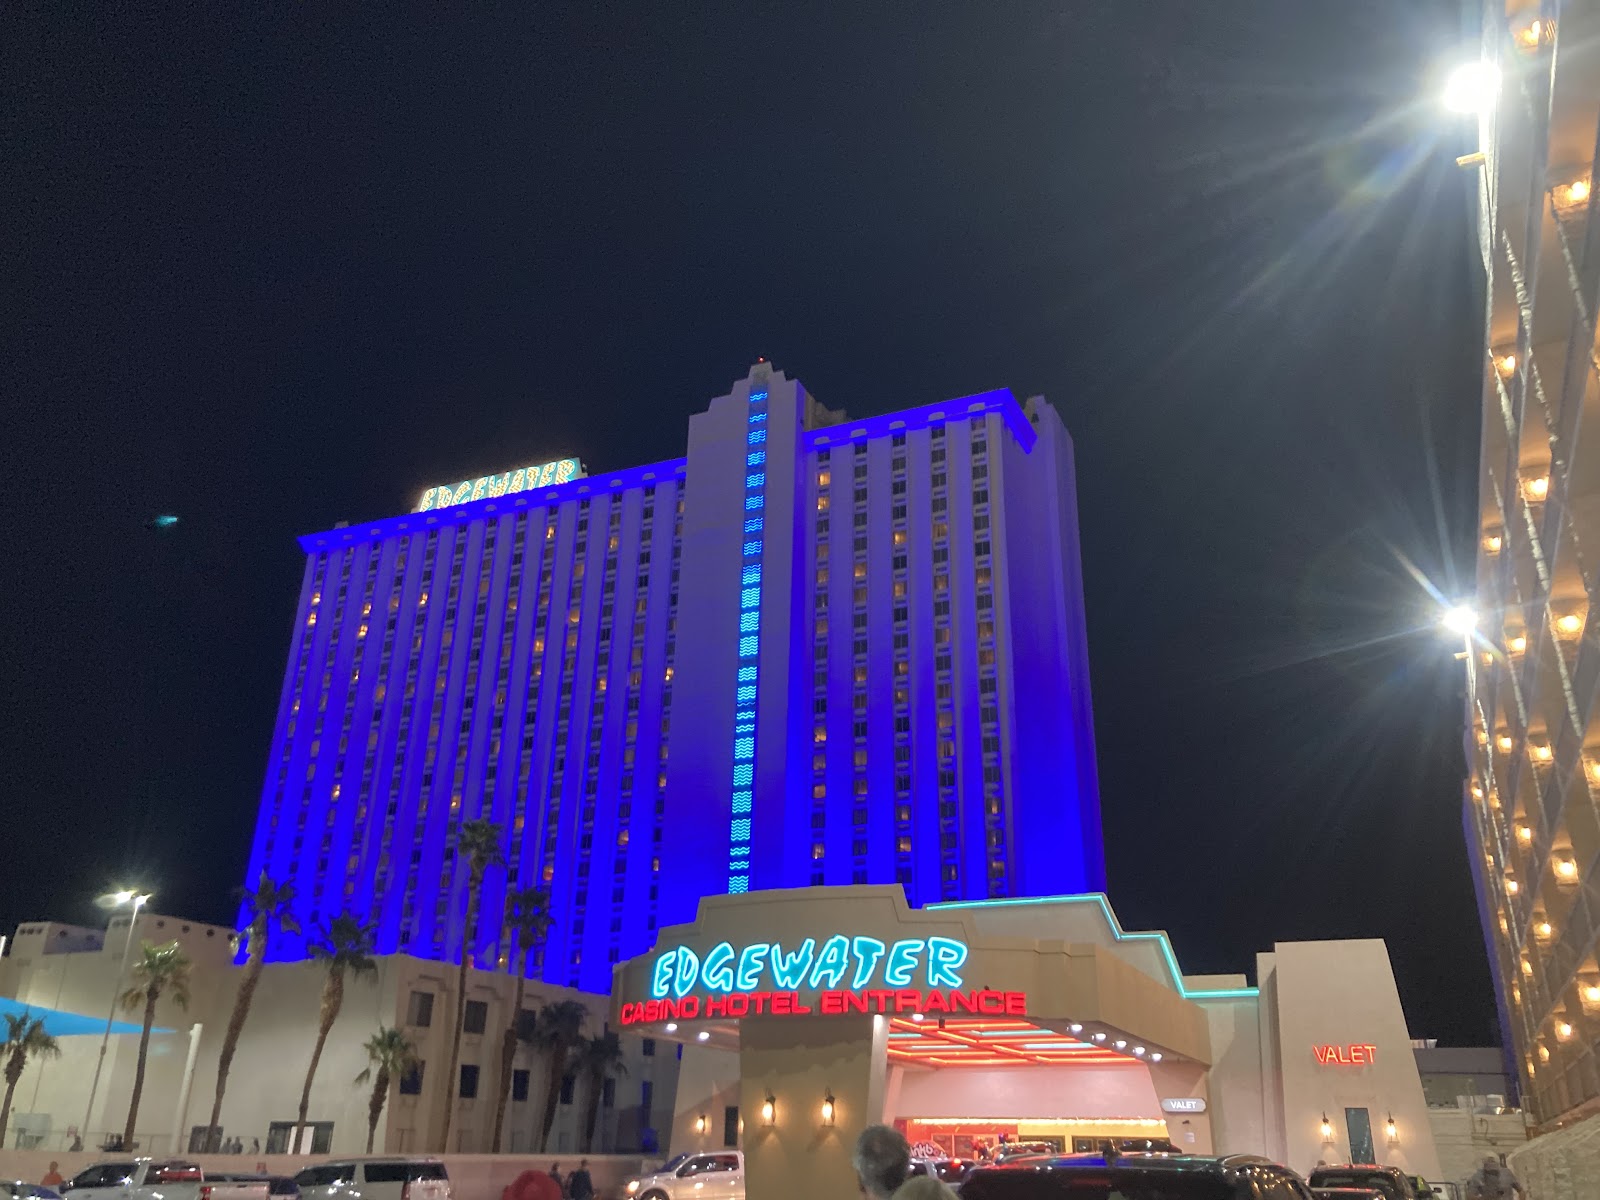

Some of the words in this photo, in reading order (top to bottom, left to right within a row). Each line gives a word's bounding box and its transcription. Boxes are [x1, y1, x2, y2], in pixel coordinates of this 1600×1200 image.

[420, 459, 575, 512] EDGEWATER
[653, 934, 968, 997] EDGEWATER
[621, 995, 699, 1025] CASINO
[706, 991, 811, 1017] HOTEL
[821, 989, 1027, 1015] ENTRANCE
[1312, 1044, 1377, 1065] VALET
[1169, 1100, 1197, 1110] VALET
